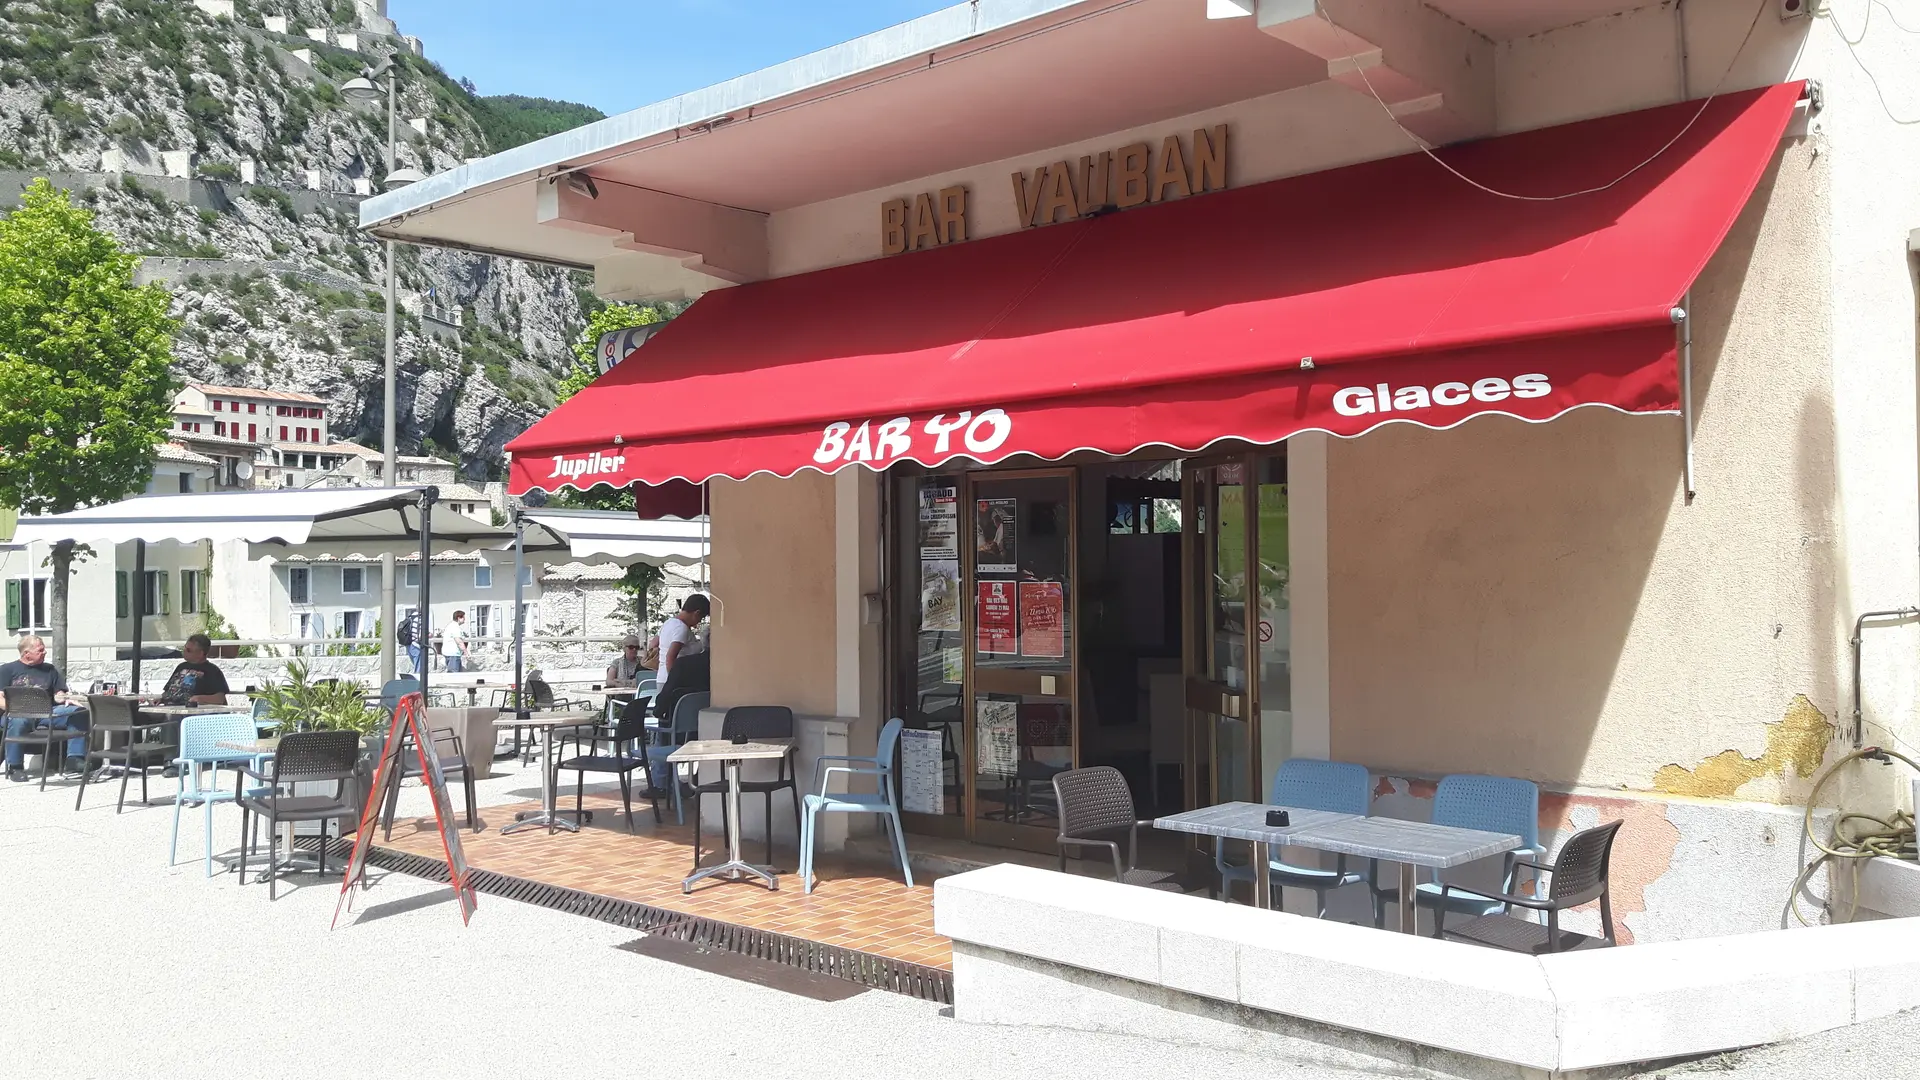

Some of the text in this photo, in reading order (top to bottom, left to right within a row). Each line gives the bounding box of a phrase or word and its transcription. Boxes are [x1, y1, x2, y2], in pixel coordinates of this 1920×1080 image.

[881, 124, 1228, 256] BAR VAUBAN
[1332, 372, 1552, 417] Glaces
[813, 408, 1012, 464] BAR YO
[547, 452, 625, 481] Jupiler
